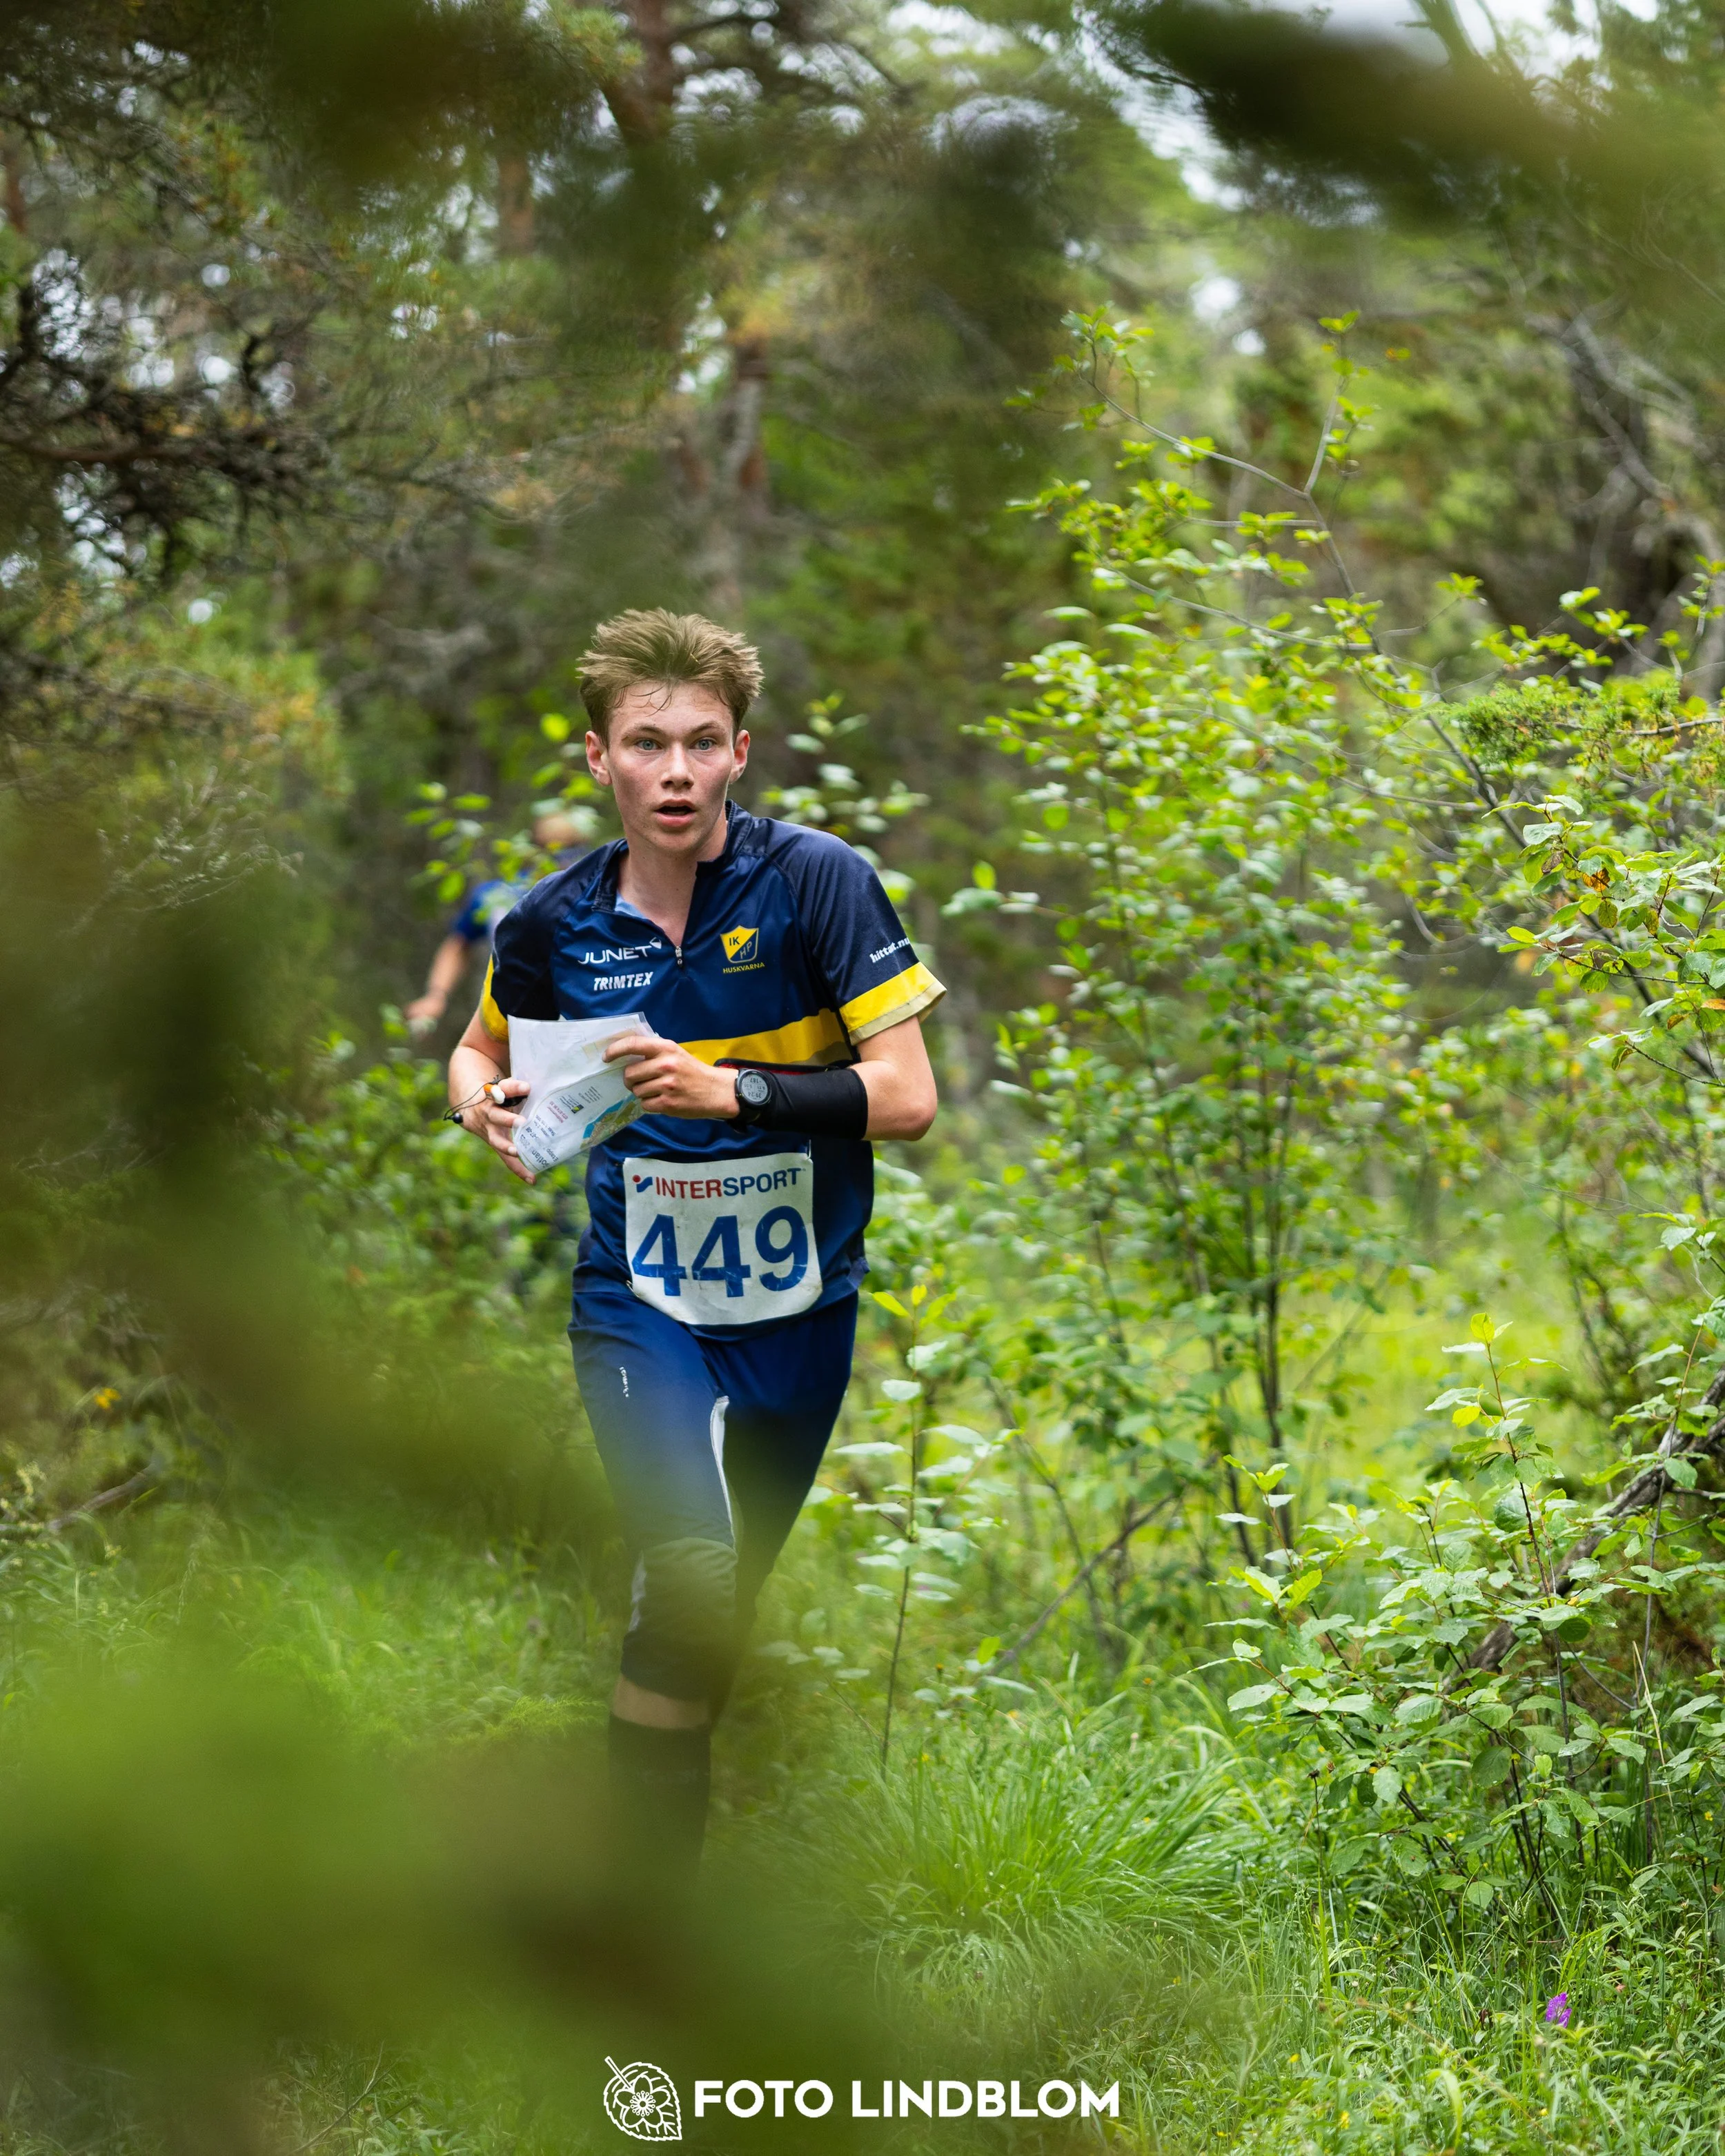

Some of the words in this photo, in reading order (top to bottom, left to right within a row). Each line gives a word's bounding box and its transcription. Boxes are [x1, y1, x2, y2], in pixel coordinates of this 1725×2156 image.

[729, 936, 740, 946] IK
[740, 941, 752, 959] HP
[578, 945, 652, 965] JUNET
[722, 962, 765, 974] HUSKVARNA
[593, 971, 653, 991] TRIMTEX
[656, 1167, 802, 1199] INTERSPORT
[631, 1205, 809, 1298] 449
